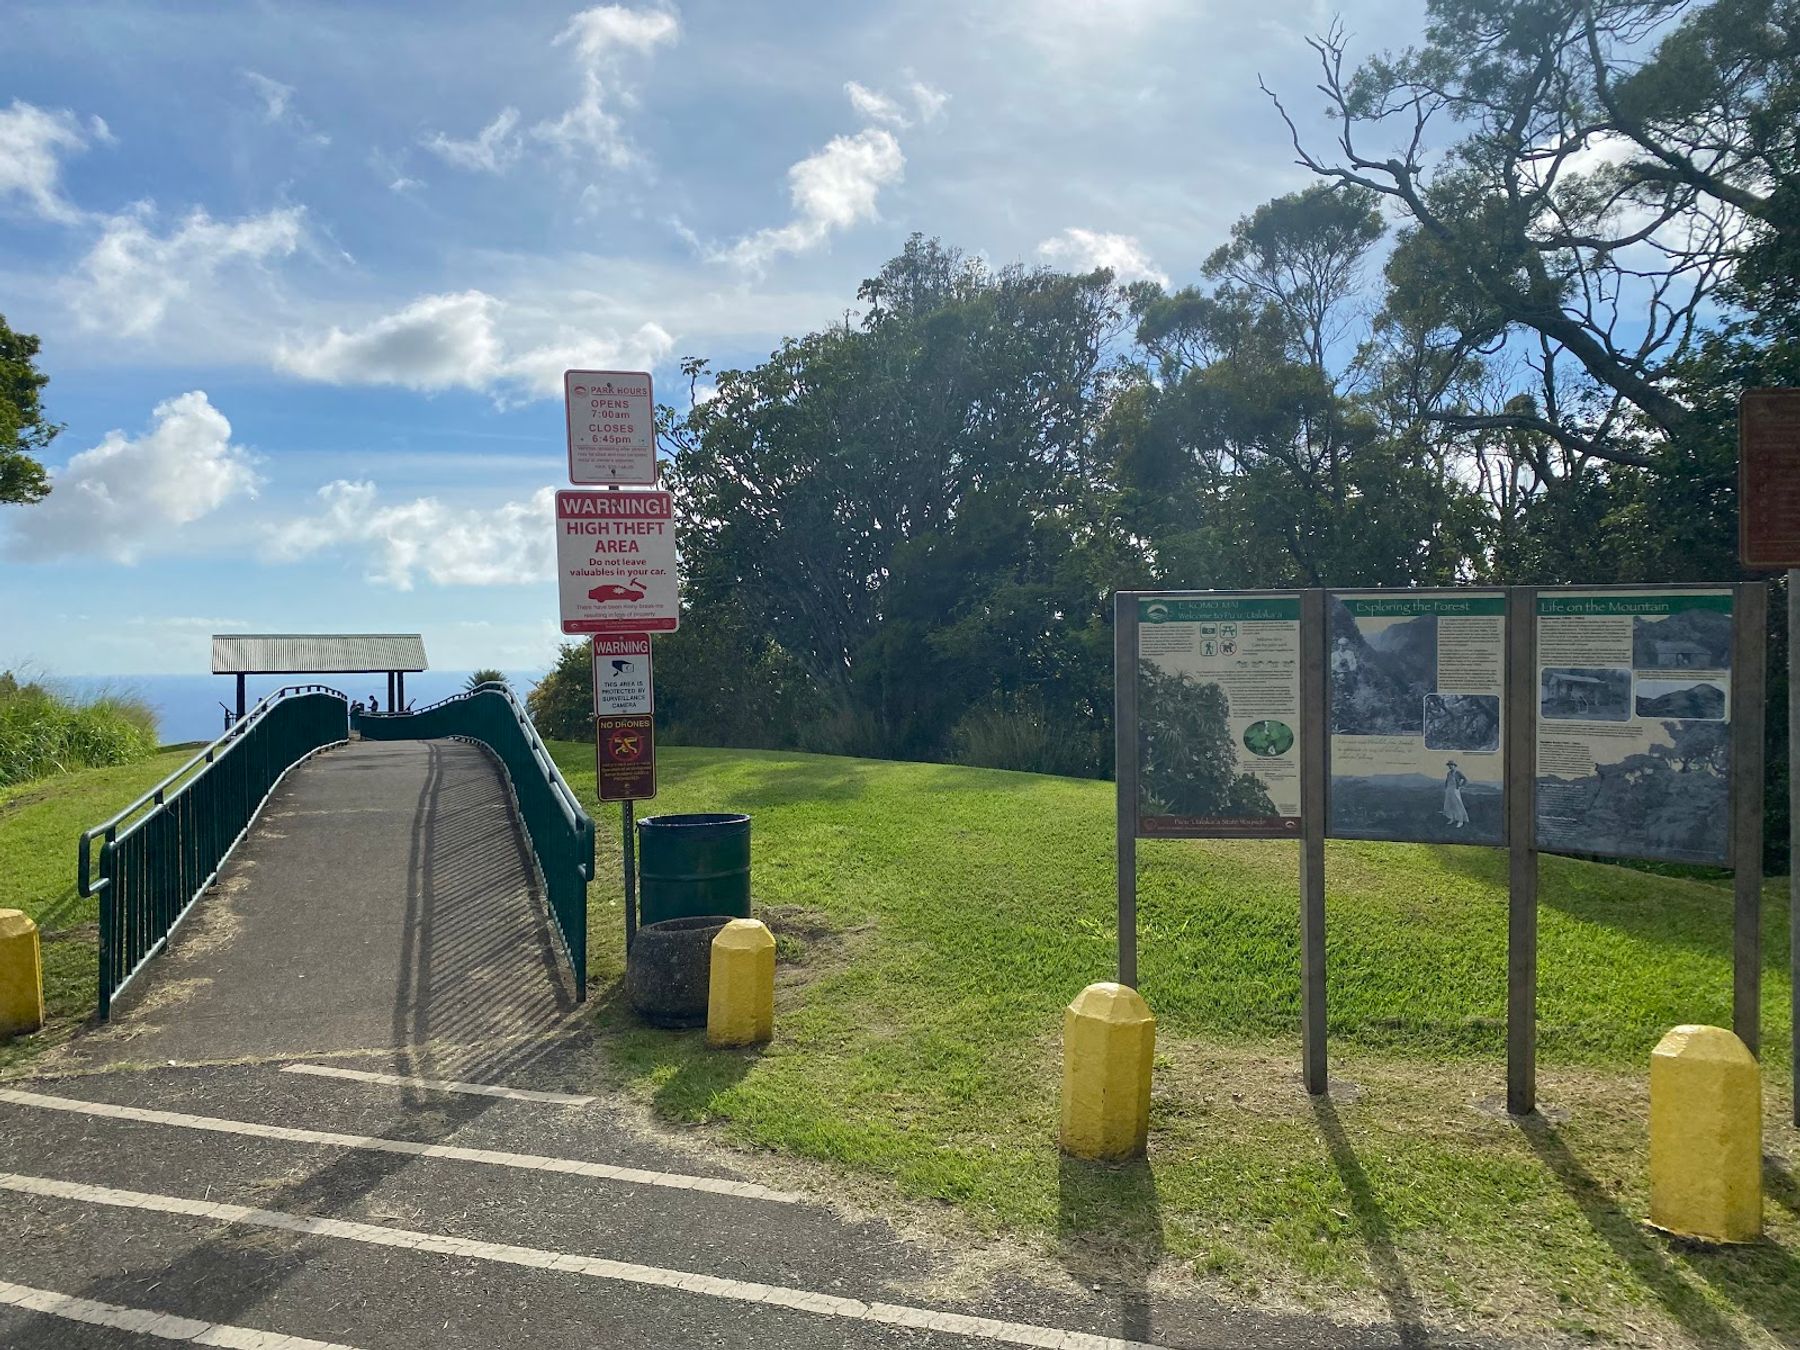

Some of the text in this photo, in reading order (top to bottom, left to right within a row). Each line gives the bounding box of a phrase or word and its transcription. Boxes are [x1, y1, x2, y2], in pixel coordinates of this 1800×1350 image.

[591, 400, 630, 408] OPENS
[592, 410, 630, 419] 7:00am
[588, 424, 634, 432] CLOSES
[592, 435, 632, 444] 6:45pm
[562, 498, 668, 514] WARNING!
[567, 522, 664, 535] HIGH THEFT
[595, 540, 640, 553] AREA
[622, 558, 646, 566] leave
[1356, 599, 1470, 616] Exploring the Forest
[1541, 600, 1670, 612] Life on the Mountain
[596, 640, 648, 654] WARNING
